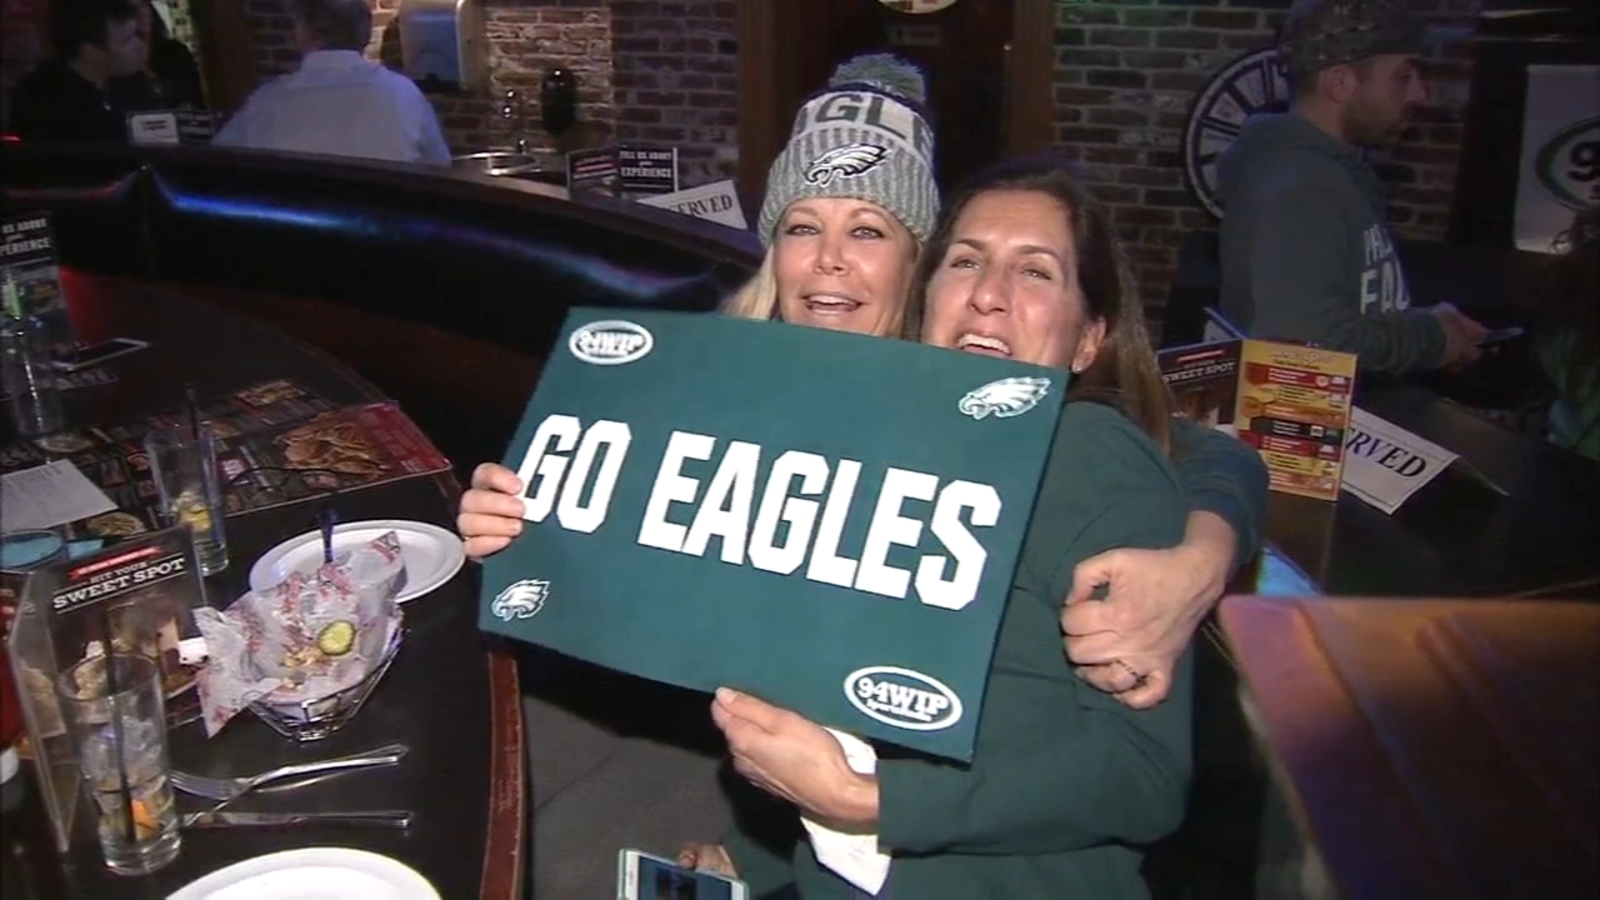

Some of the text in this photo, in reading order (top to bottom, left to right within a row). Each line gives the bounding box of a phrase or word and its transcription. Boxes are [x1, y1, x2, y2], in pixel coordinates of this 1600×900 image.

[620, 167, 672, 178] EXPERIENCE
[1346, 426, 1427, 478] RVED
[515, 413, 1002, 611] GO EAGLES
[53, 576, 132, 609] SWEET
[133, 557, 186, 584] SPOT
[114, 561, 148, 575] YOUR
[857, 677, 949, 715] 94WIP
